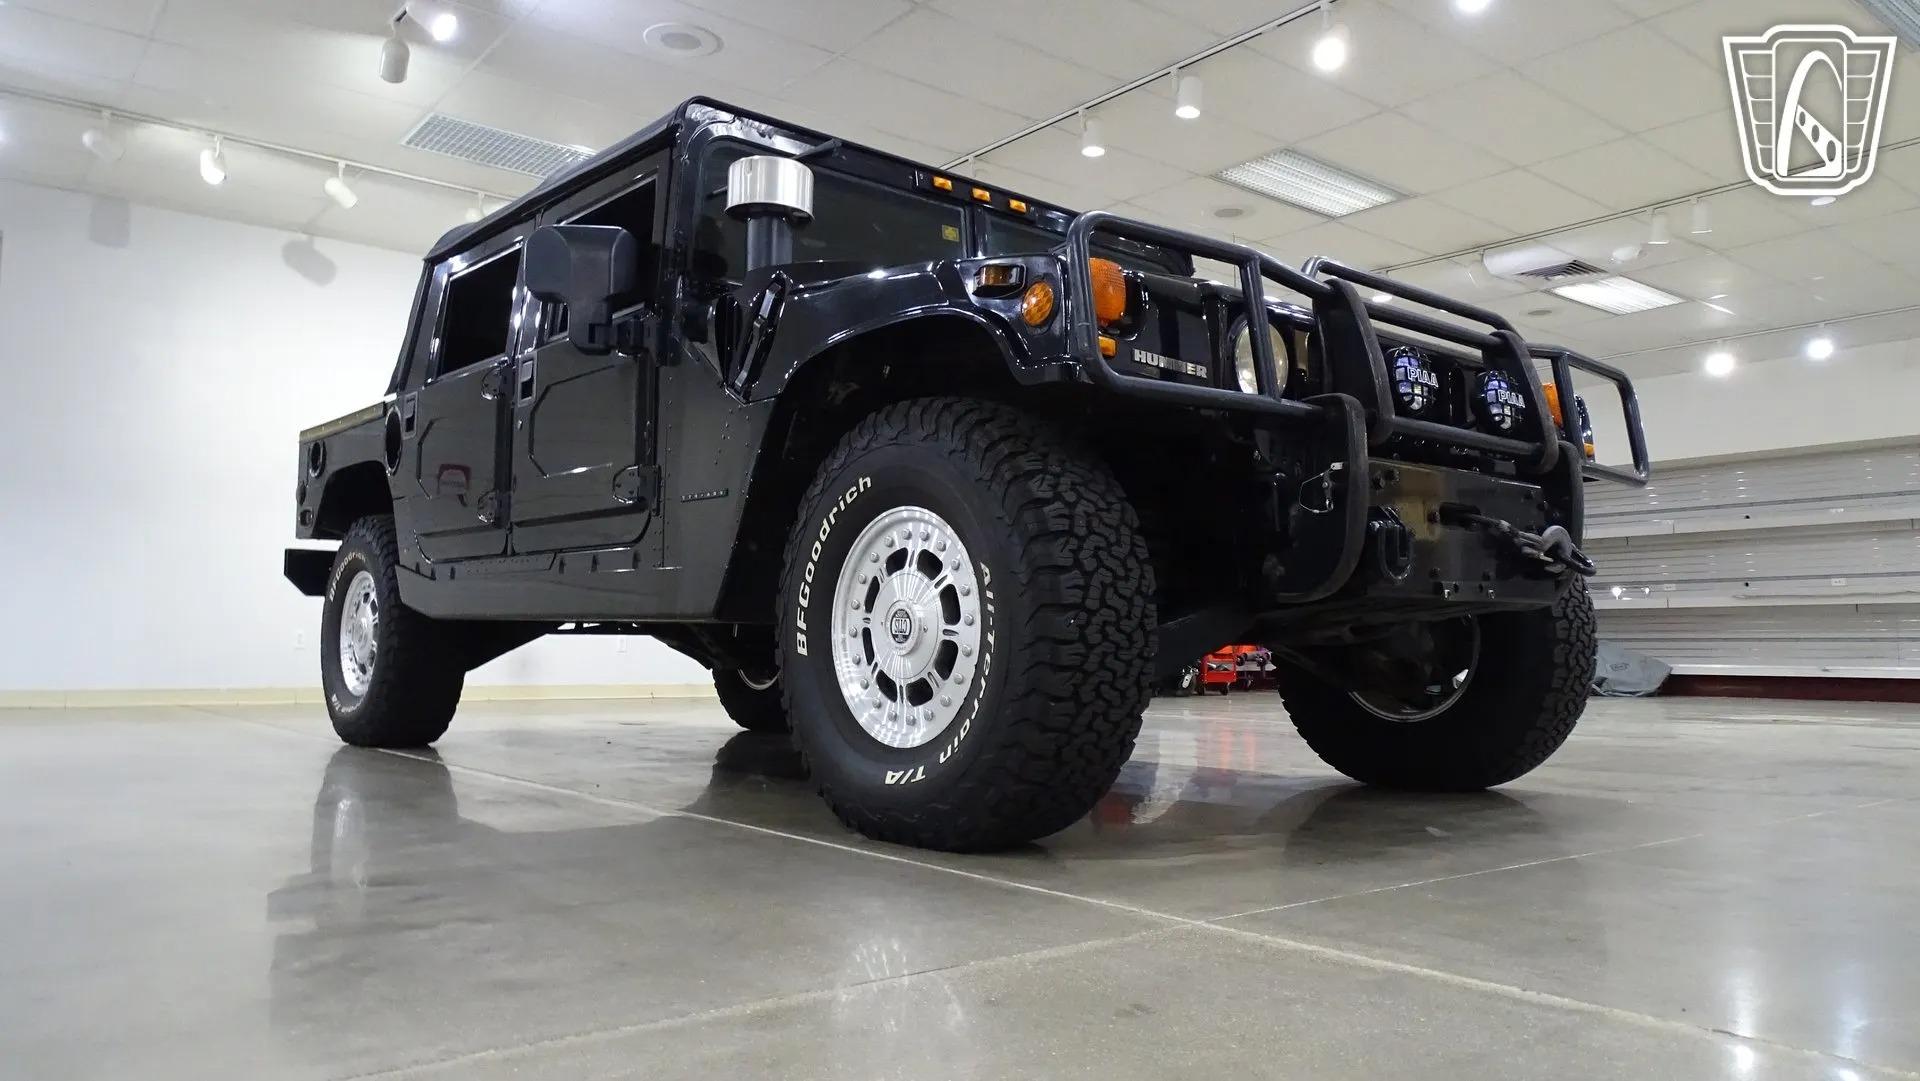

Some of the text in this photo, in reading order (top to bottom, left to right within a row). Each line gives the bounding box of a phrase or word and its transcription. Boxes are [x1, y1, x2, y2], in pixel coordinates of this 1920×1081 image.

[797, 475, 872, 656] BFGoodrich
[885, 561, 995, 785] All-Terrain T/A
